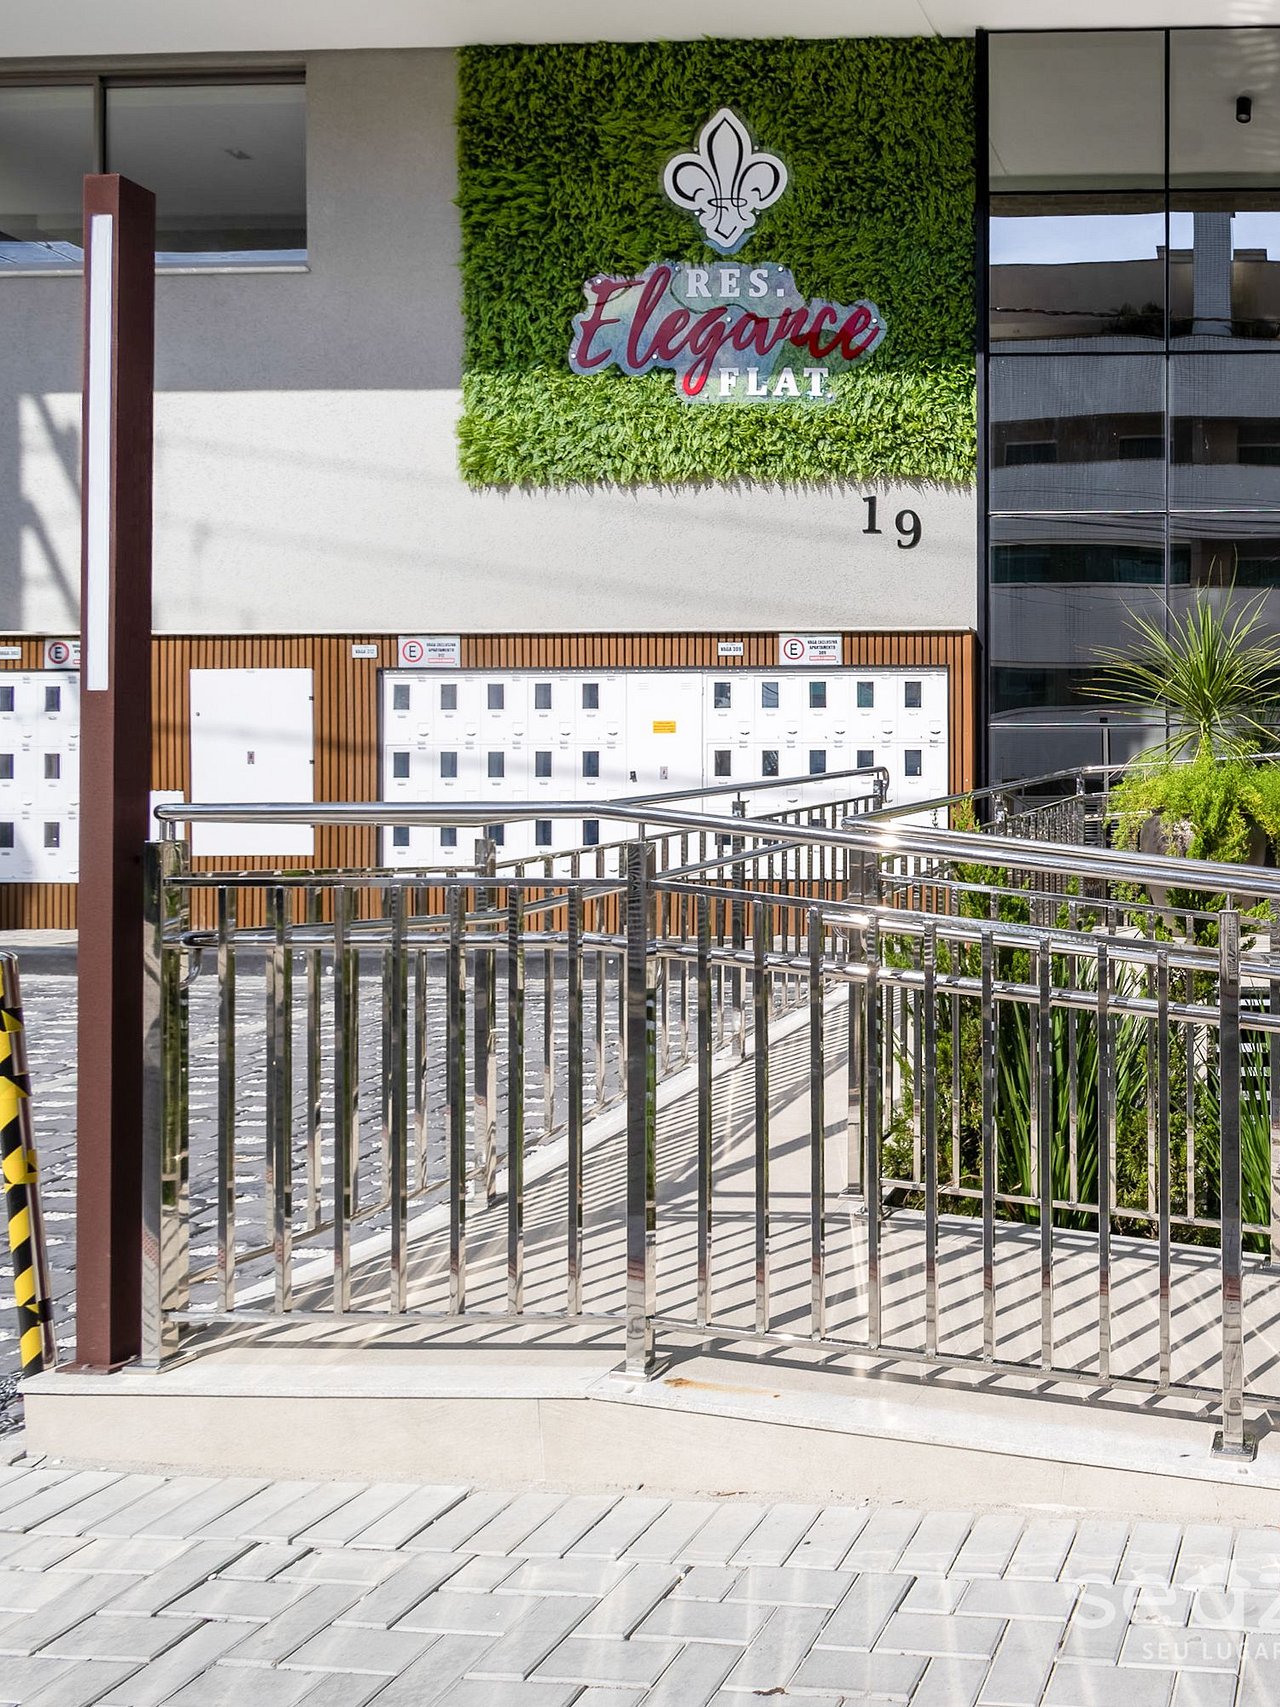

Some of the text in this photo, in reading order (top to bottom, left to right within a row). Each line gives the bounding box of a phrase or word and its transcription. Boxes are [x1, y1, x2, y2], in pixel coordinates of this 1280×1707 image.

[685, 268, 785, 298] RES.
[576, 266, 879, 396] Elegance
[718, 367, 830, 397] FLAT
[862, 496, 922, 550] 19
[54, 646, 63, 659] E
[409, 645, 417, 658] E
[789, 643, 798, 656] E
